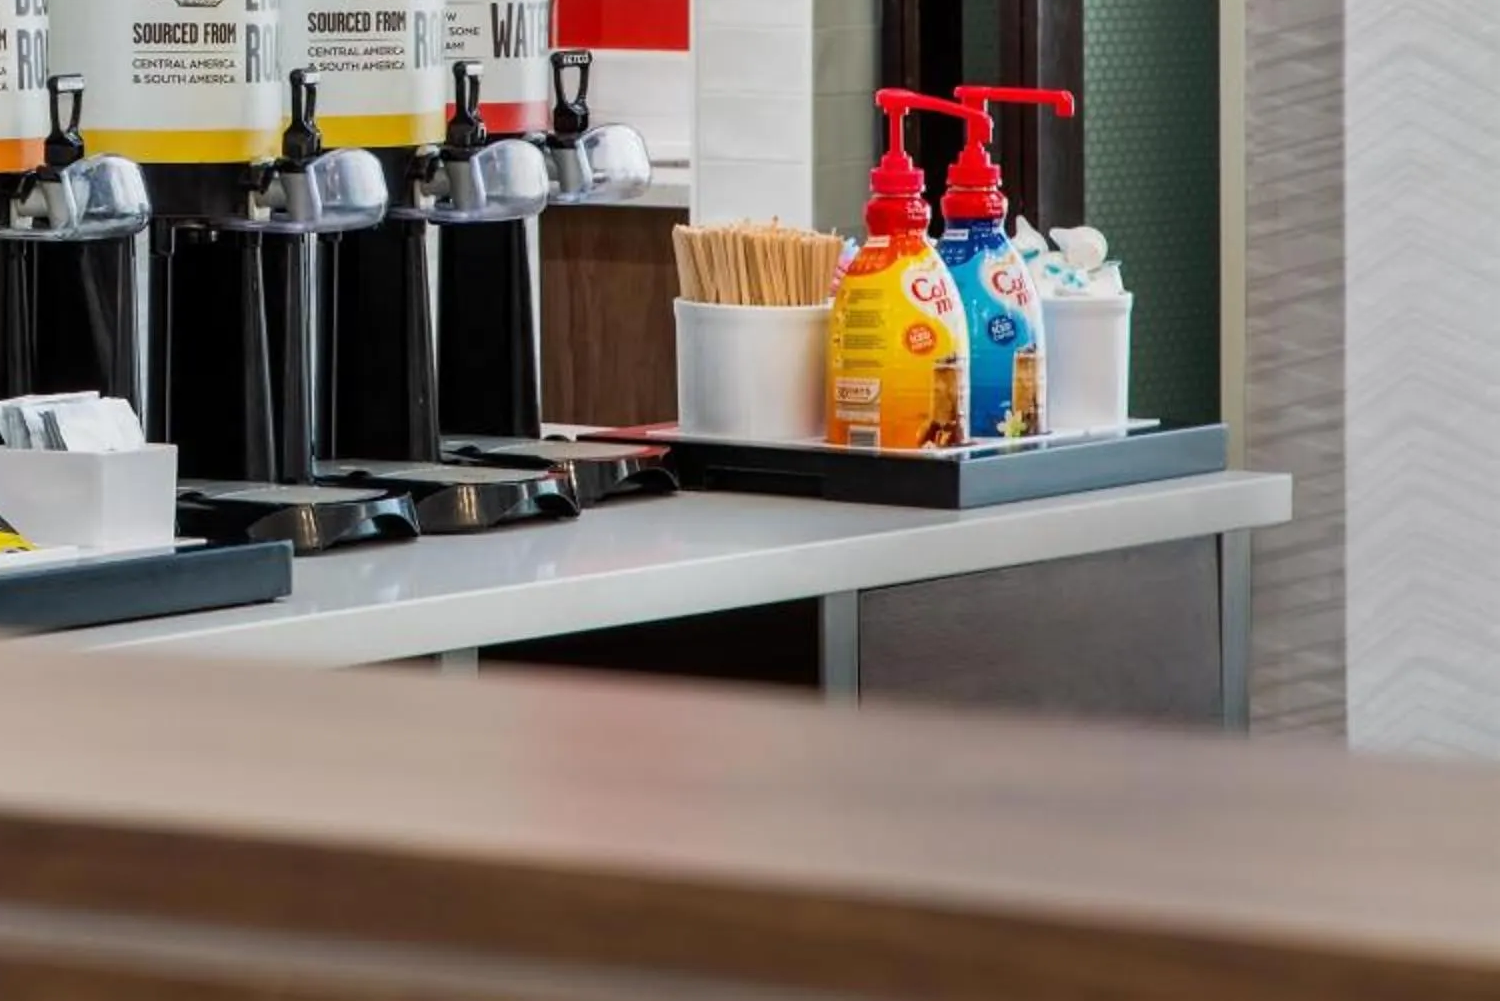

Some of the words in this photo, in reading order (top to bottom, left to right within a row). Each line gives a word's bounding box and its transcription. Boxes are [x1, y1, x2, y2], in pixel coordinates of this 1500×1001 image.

[307, 10, 371, 33] SOURCED
[376, 10, 406, 32] FROM
[132, 22, 199, 45] SOURCED
[203, 22, 237, 45] FROM
[307, 46, 358, 58] CENTRAL
[361, 46, 405, 57] AMERICA
[132, 58, 187, 70] CENTRAL
[189, 58, 237, 69] AMERICA
[318, 61, 361, 72] SOUTH
[362, 61, 405, 72] AMERICA
[143, 74, 187, 84] SOUTH
[188, 74, 237, 84] AMERICA
